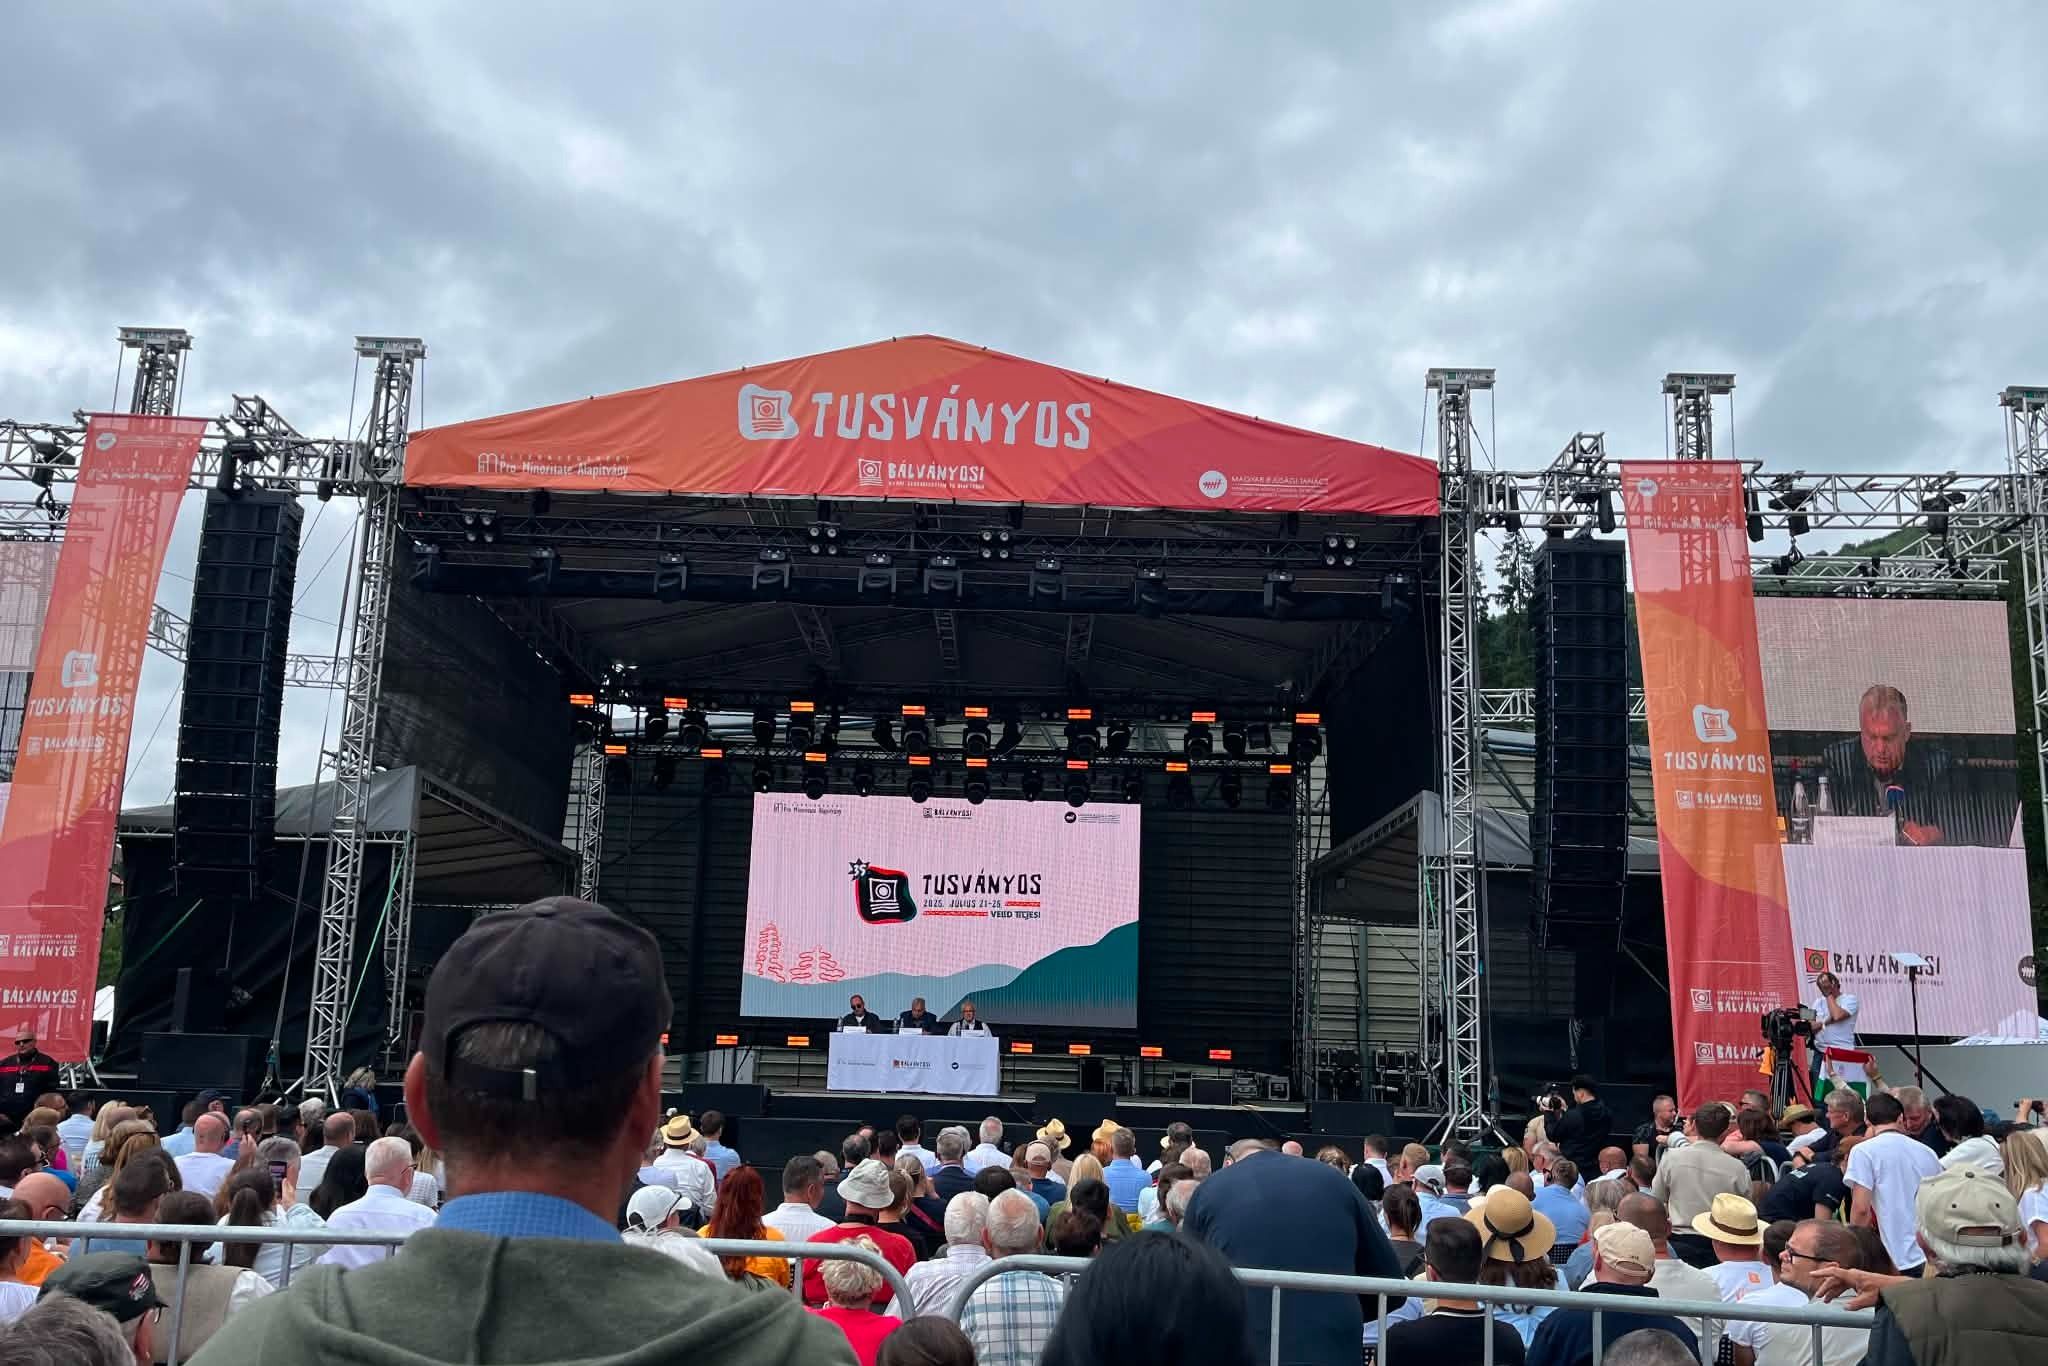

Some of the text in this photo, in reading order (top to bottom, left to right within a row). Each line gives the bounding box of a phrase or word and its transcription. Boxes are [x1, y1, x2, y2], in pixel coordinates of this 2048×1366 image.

[811, 384, 1092, 450] TUSVÁNYOS
[887, 460, 985, 482] BÁLVÁNYOSI
[28, 690, 122, 717] TUSVÁNYOS
[1664, 747, 1767, 774] TUSVÁNYOS
[853, 864, 866, 877] 35
[922, 868, 1042, 895] TUSVÁNYOS
[13, 943, 77, 957] BÁLVÁNYOS
[3, 987, 78, 1004] BÁLVÁNYOS
